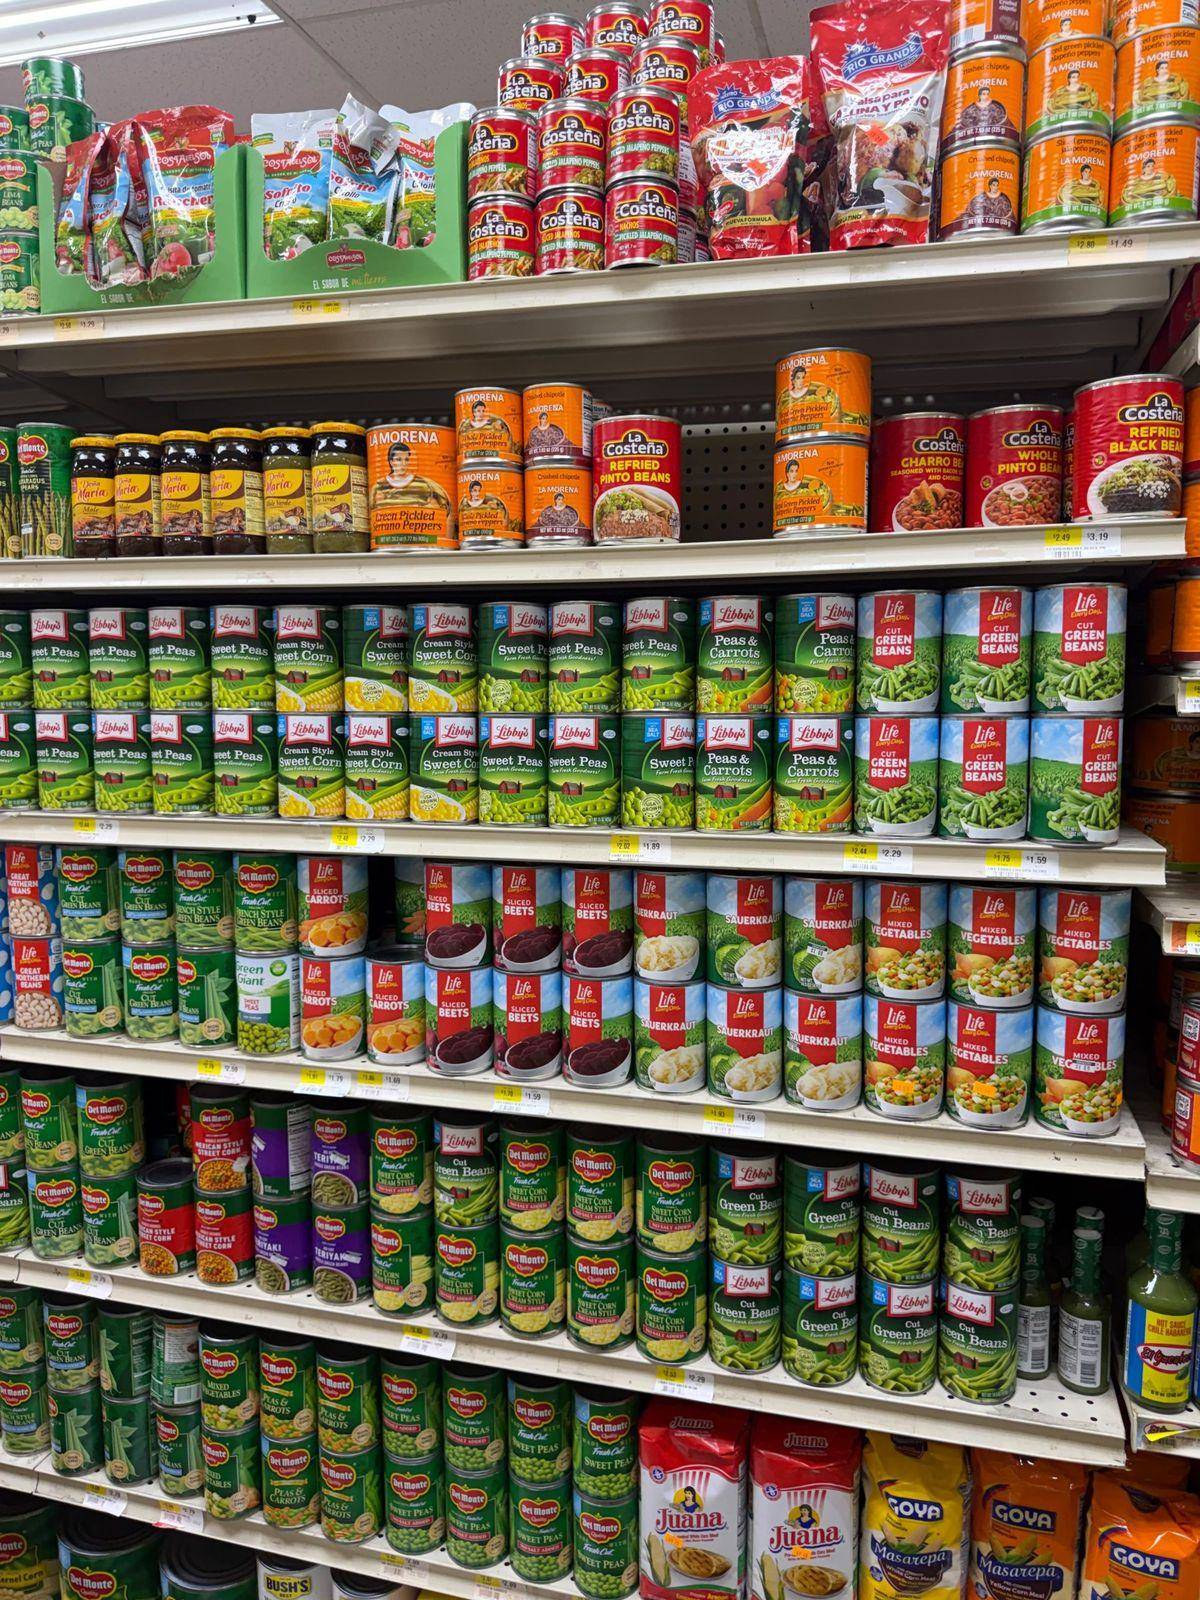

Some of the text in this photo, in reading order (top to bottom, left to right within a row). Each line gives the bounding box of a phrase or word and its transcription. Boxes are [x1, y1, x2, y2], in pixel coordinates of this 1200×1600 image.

[1053, 9, 1089, 17] MORENA
[621, 21, 633, 31] La
[848, 43, 918, 73] RIO GRANDE
[1150, 51, 1188, 59] MORENA
[1061, 61, 1098, 69] MORENA
[970, 78, 1008, 87] MORENA
[632, 103, 647, 114] La
[564, 118, 578, 129] La
[543, 130, 600, 145] Costeña
[1139, 149, 1175, 159] MORENA
[1071, 158, 1105, 166] MORENA
[979, 171, 1013, 179] MORENA
[645, 191, 659, 202] La
[563, 201, 577, 212] La
[486, 213, 499, 223] La
[621, 205, 676, 221] Costeña
[541, 213, 599, 230] Costeña
[471, 225, 523, 238] Costeña
[1111, 239, 1132, 248] $1.49
[313, 277, 349, 289] EL SABOR DE
[788, 356, 827, 368] MORENA
[466, 393, 504, 401] MORENA
[1155, 398, 1167, 407] La
[1125, 408, 1182, 421] Costeña
[1036, 424, 1047, 433] La
[1130, 427, 1180, 438] REFRIED
[369, 431, 438, 446] LA MORENA
[629, 434, 641, 442] La
[944, 431, 953, 439] La
[607, 443, 663, 455] Costeña
[1110, 441, 1157, 453] BLACK
[783, 450, 818, 461] MORENA
[1018, 451, 1058, 460] WHOLE
[610, 460, 659, 471] REFRIED
[901, 457, 950, 467] CHARRO
[891, 468, 923, 476] SEASONED
[998, 463, 1037, 474] PINTO
[600, 472, 670, 483] PINTO BEANS
[266, 481, 291, 492] Maria
[547, 486, 578, 494] MORENA
[78, 488, 105, 498] Maria
[400, 511, 435, 521] Pickled
[403, 520, 442, 531] Peppers
[992, 597, 1012, 616] Life
[1075, 593, 1098, 612] Life
[884, 600, 904, 619] Life
[219, 614, 250, 628] Libby's
[434, 612, 466, 628] Libby's
[720, 608, 754, 623] Libby's
[281, 615, 313, 630] Libby's
[715, 635, 758, 645] Peas &
[876, 634, 912, 644] GREEN
[982, 632, 1018, 642] GREEN
[1064, 630, 1104, 640] GREEN
[240, 644, 268, 656] Peas
[276, 642, 324, 650] Cream Style
[499, 645, 534, 655] Sweet
[876, 646, 912, 656] BEANS
[982, 643, 1018, 654] BEANS
[1064, 641, 1104, 651] BEANS
[50, 647, 80, 658] Peas
[109, 647, 137, 657] Peas
[302, 651, 333, 662] Corn
[710, 648, 759, 659] Carrots
[100, 721, 129, 734] Libby's
[293, 721, 324, 736] Libby's
[497, 725, 529, 739] Libby's
[795, 726, 833, 741] Libby's
[119, 749, 147, 760] Peas
[310, 747, 334, 755] Style
[280, 756, 341, 767] Sweet Corn
[483, 756, 542, 767] Sweet Peas
[793, 755, 837, 765] Peas &
[788, 767, 839, 778] Carrots
[882, 849, 901, 857] $2.29
[1027, 856, 1046, 864] $1.59
[128, 864, 160, 872] Del Monte
[306, 895, 349, 903] CARROTS
[505, 906, 534, 916] BEETS
[961, 932, 1026, 945] VEGETABLES
[22, 946, 37, 959] Life
[239, 976, 265, 986] Giant
[508, 1013, 539, 1022] BEETS
[641, 1019, 695, 1030] SAUERKRAUT
[717, 1026, 774, 1037] SAUERKRAUT
[870, 1040, 928, 1056] VEGETABLES
[222, 1147, 241, 1155] CORN
[509, 1151, 547, 1160] Del Monte
[50, 1186, 73, 1195] Monte
[875, 1183, 910, 1197] Libby's
[893, 1218, 930, 1231] Beans
[740, 1301, 756, 1309] Cut
[714, 1304, 780, 1318] Green Beans
[584, 1457, 634, 1469] SWEET PEAS
[888, 1497, 941, 1520] GOYA
[656, 1508, 723, 1530] Juana
[994, 1504, 1054, 1528] GOYA
[769, 1526, 841, 1549] Juana
[875, 1544, 948, 1566] Masarepa
[979, 1557, 1056, 1577] Masarepa
[1113, 1548, 1175, 1575] GOYA
[266, 1578, 308, 1592] BUSH'S
